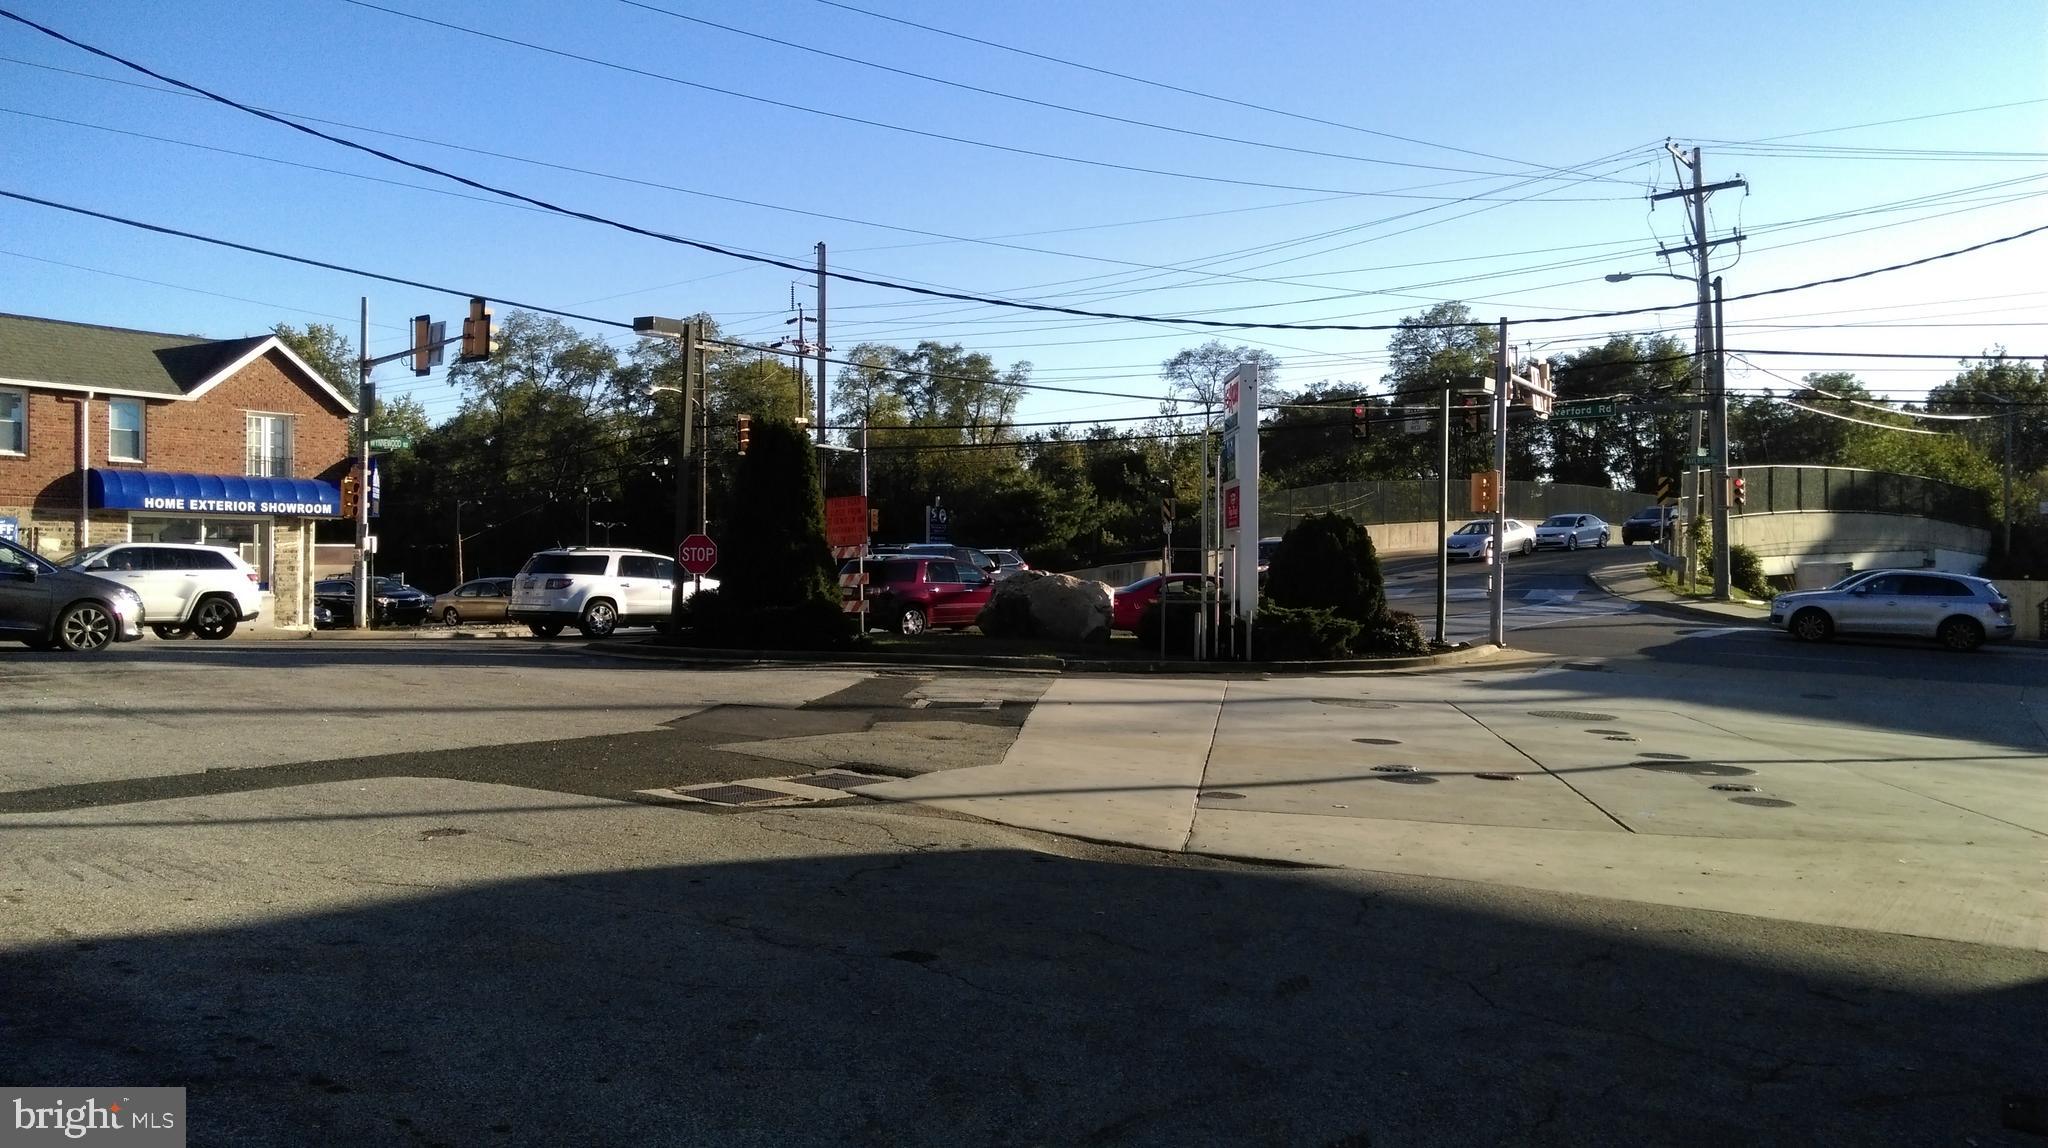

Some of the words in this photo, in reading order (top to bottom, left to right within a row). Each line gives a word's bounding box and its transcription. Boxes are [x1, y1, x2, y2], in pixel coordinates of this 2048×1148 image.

[1598, 404, 1612, 414] Rd
[144, 497, 185, 510] HOME
[189, 499, 256, 512] EXTERIOR
[260, 502, 332, 514] SHOWROOM
[682, 546, 715, 562] STOP
